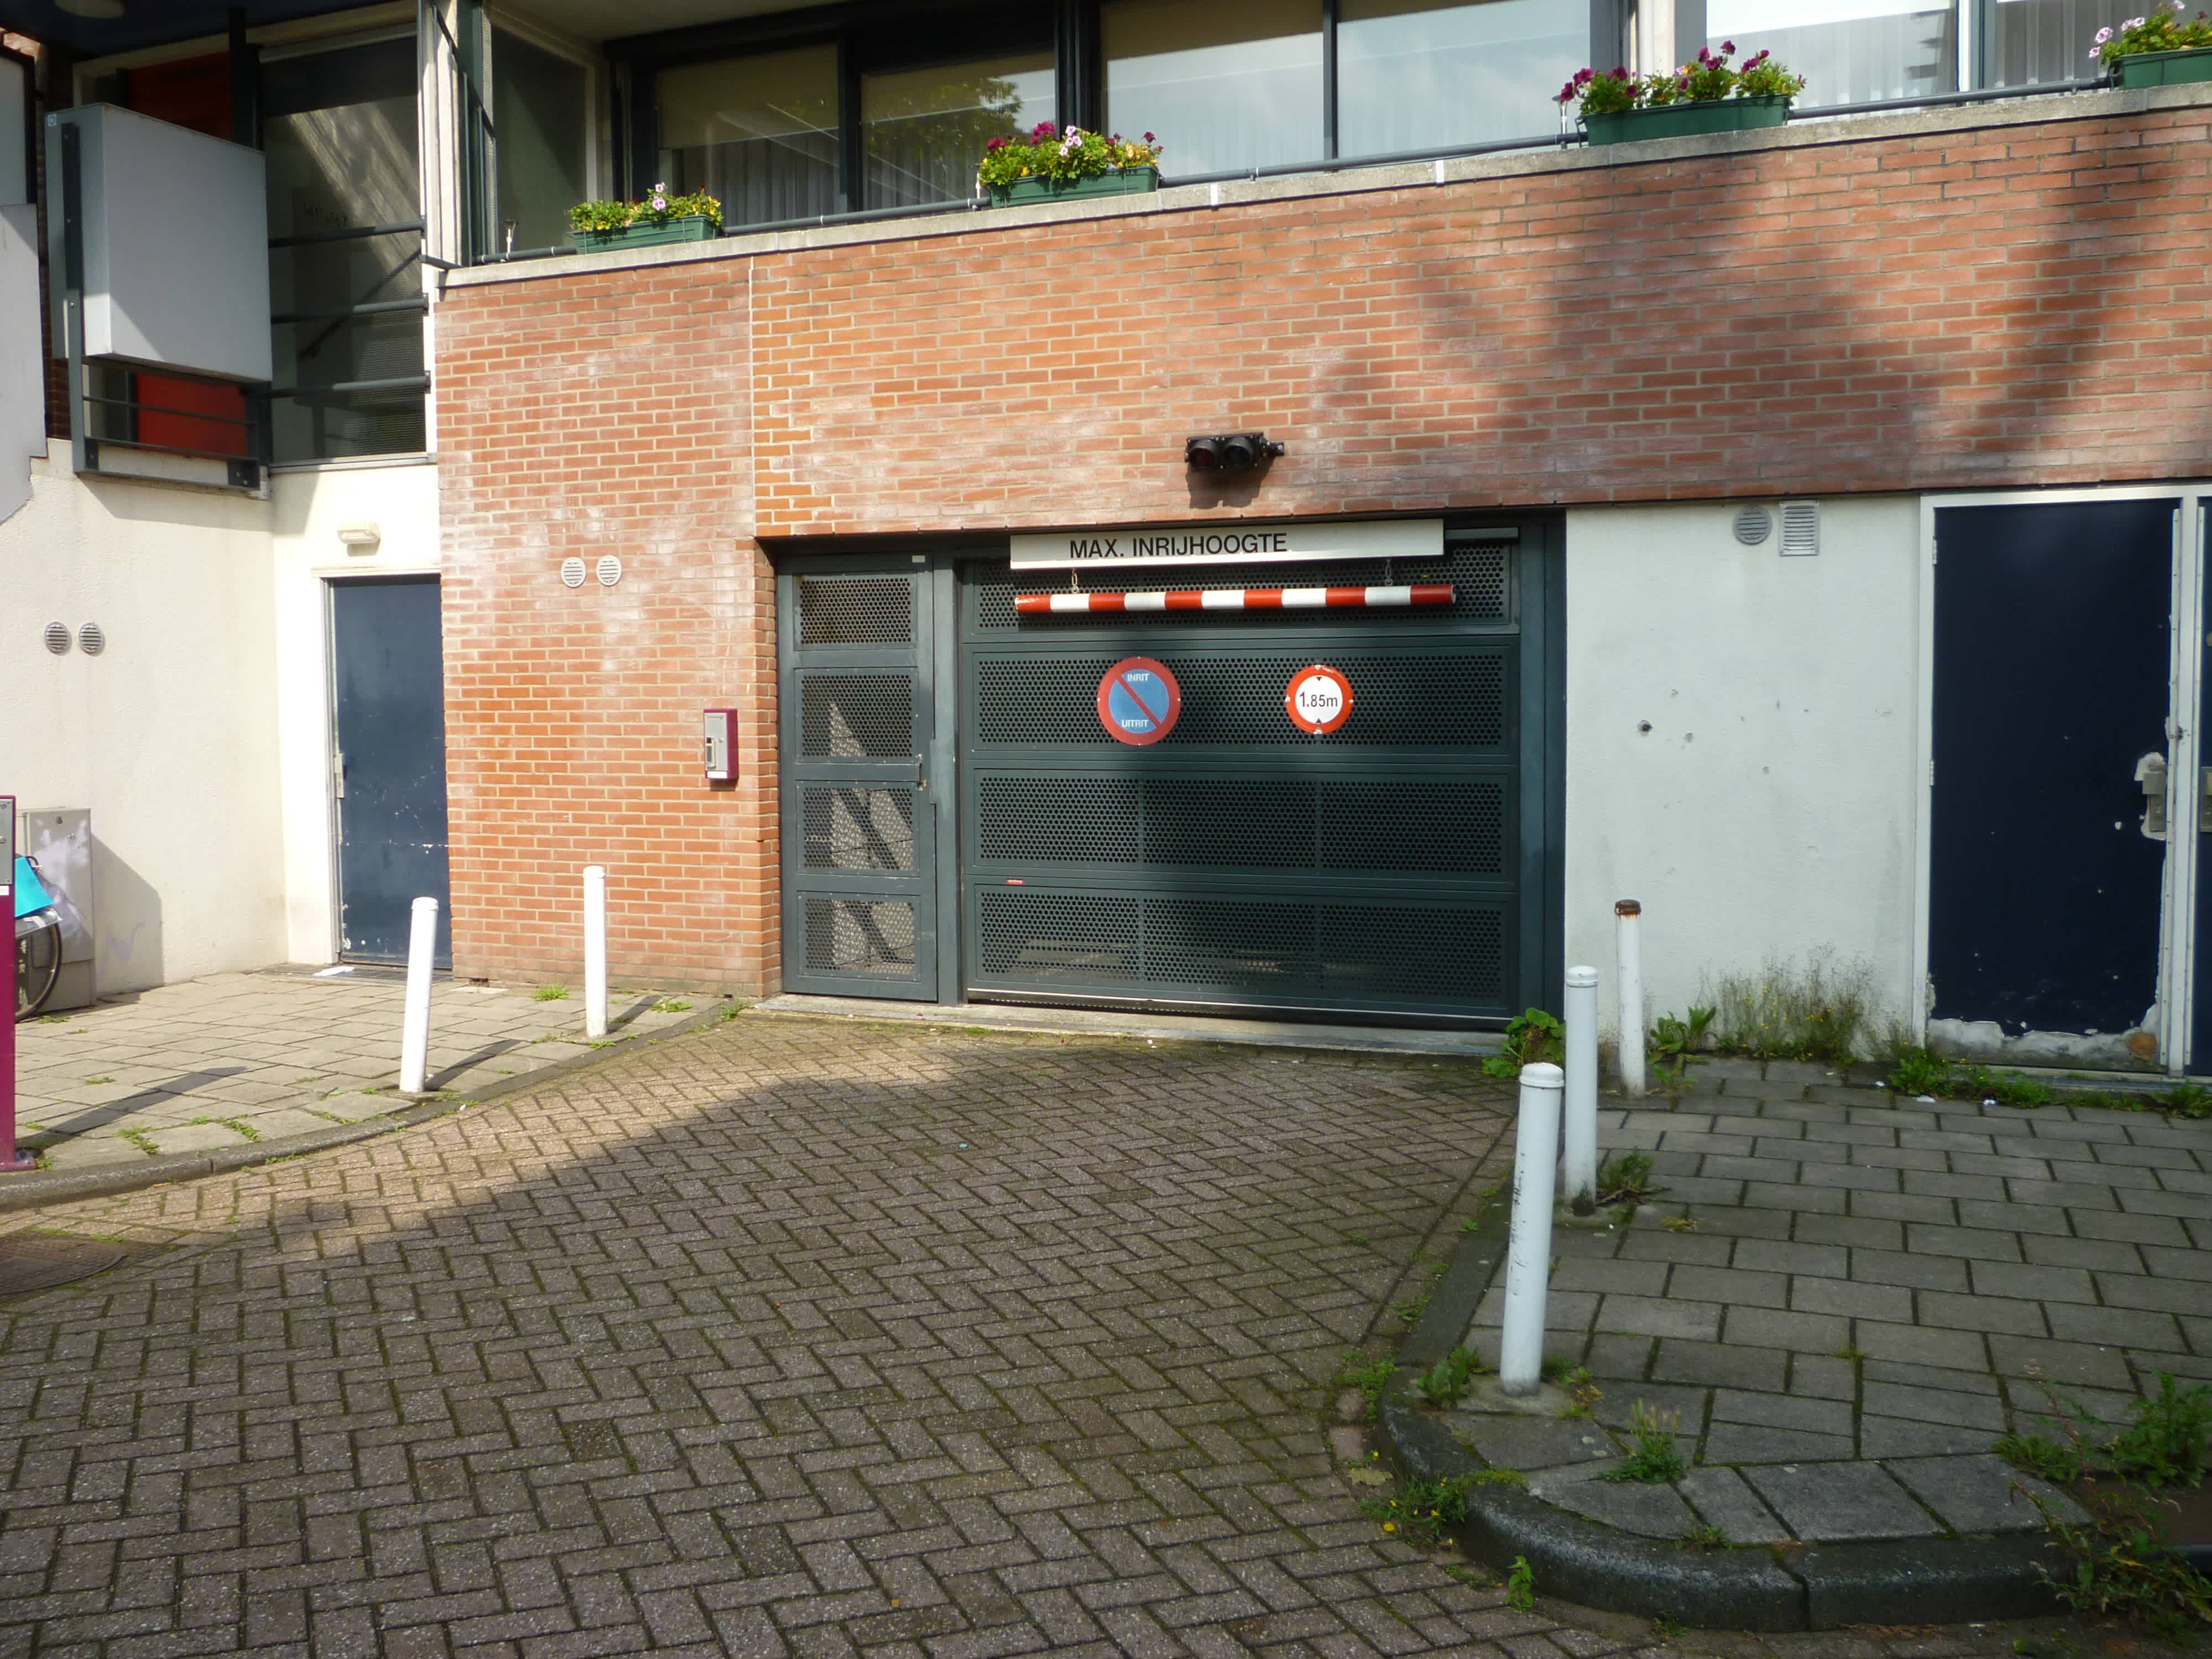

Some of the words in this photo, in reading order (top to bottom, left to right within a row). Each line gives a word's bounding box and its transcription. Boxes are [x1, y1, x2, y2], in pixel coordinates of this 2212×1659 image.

[1070, 539, 1124, 558] MAX.
[1133, 533, 1287, 556] INRIJHOOGTE
[1127, 673, 1150, 682] INRIT
[1300, 691, 1338, 707] 1.85m
[1121, 719, 1149, 727] UITRIT
